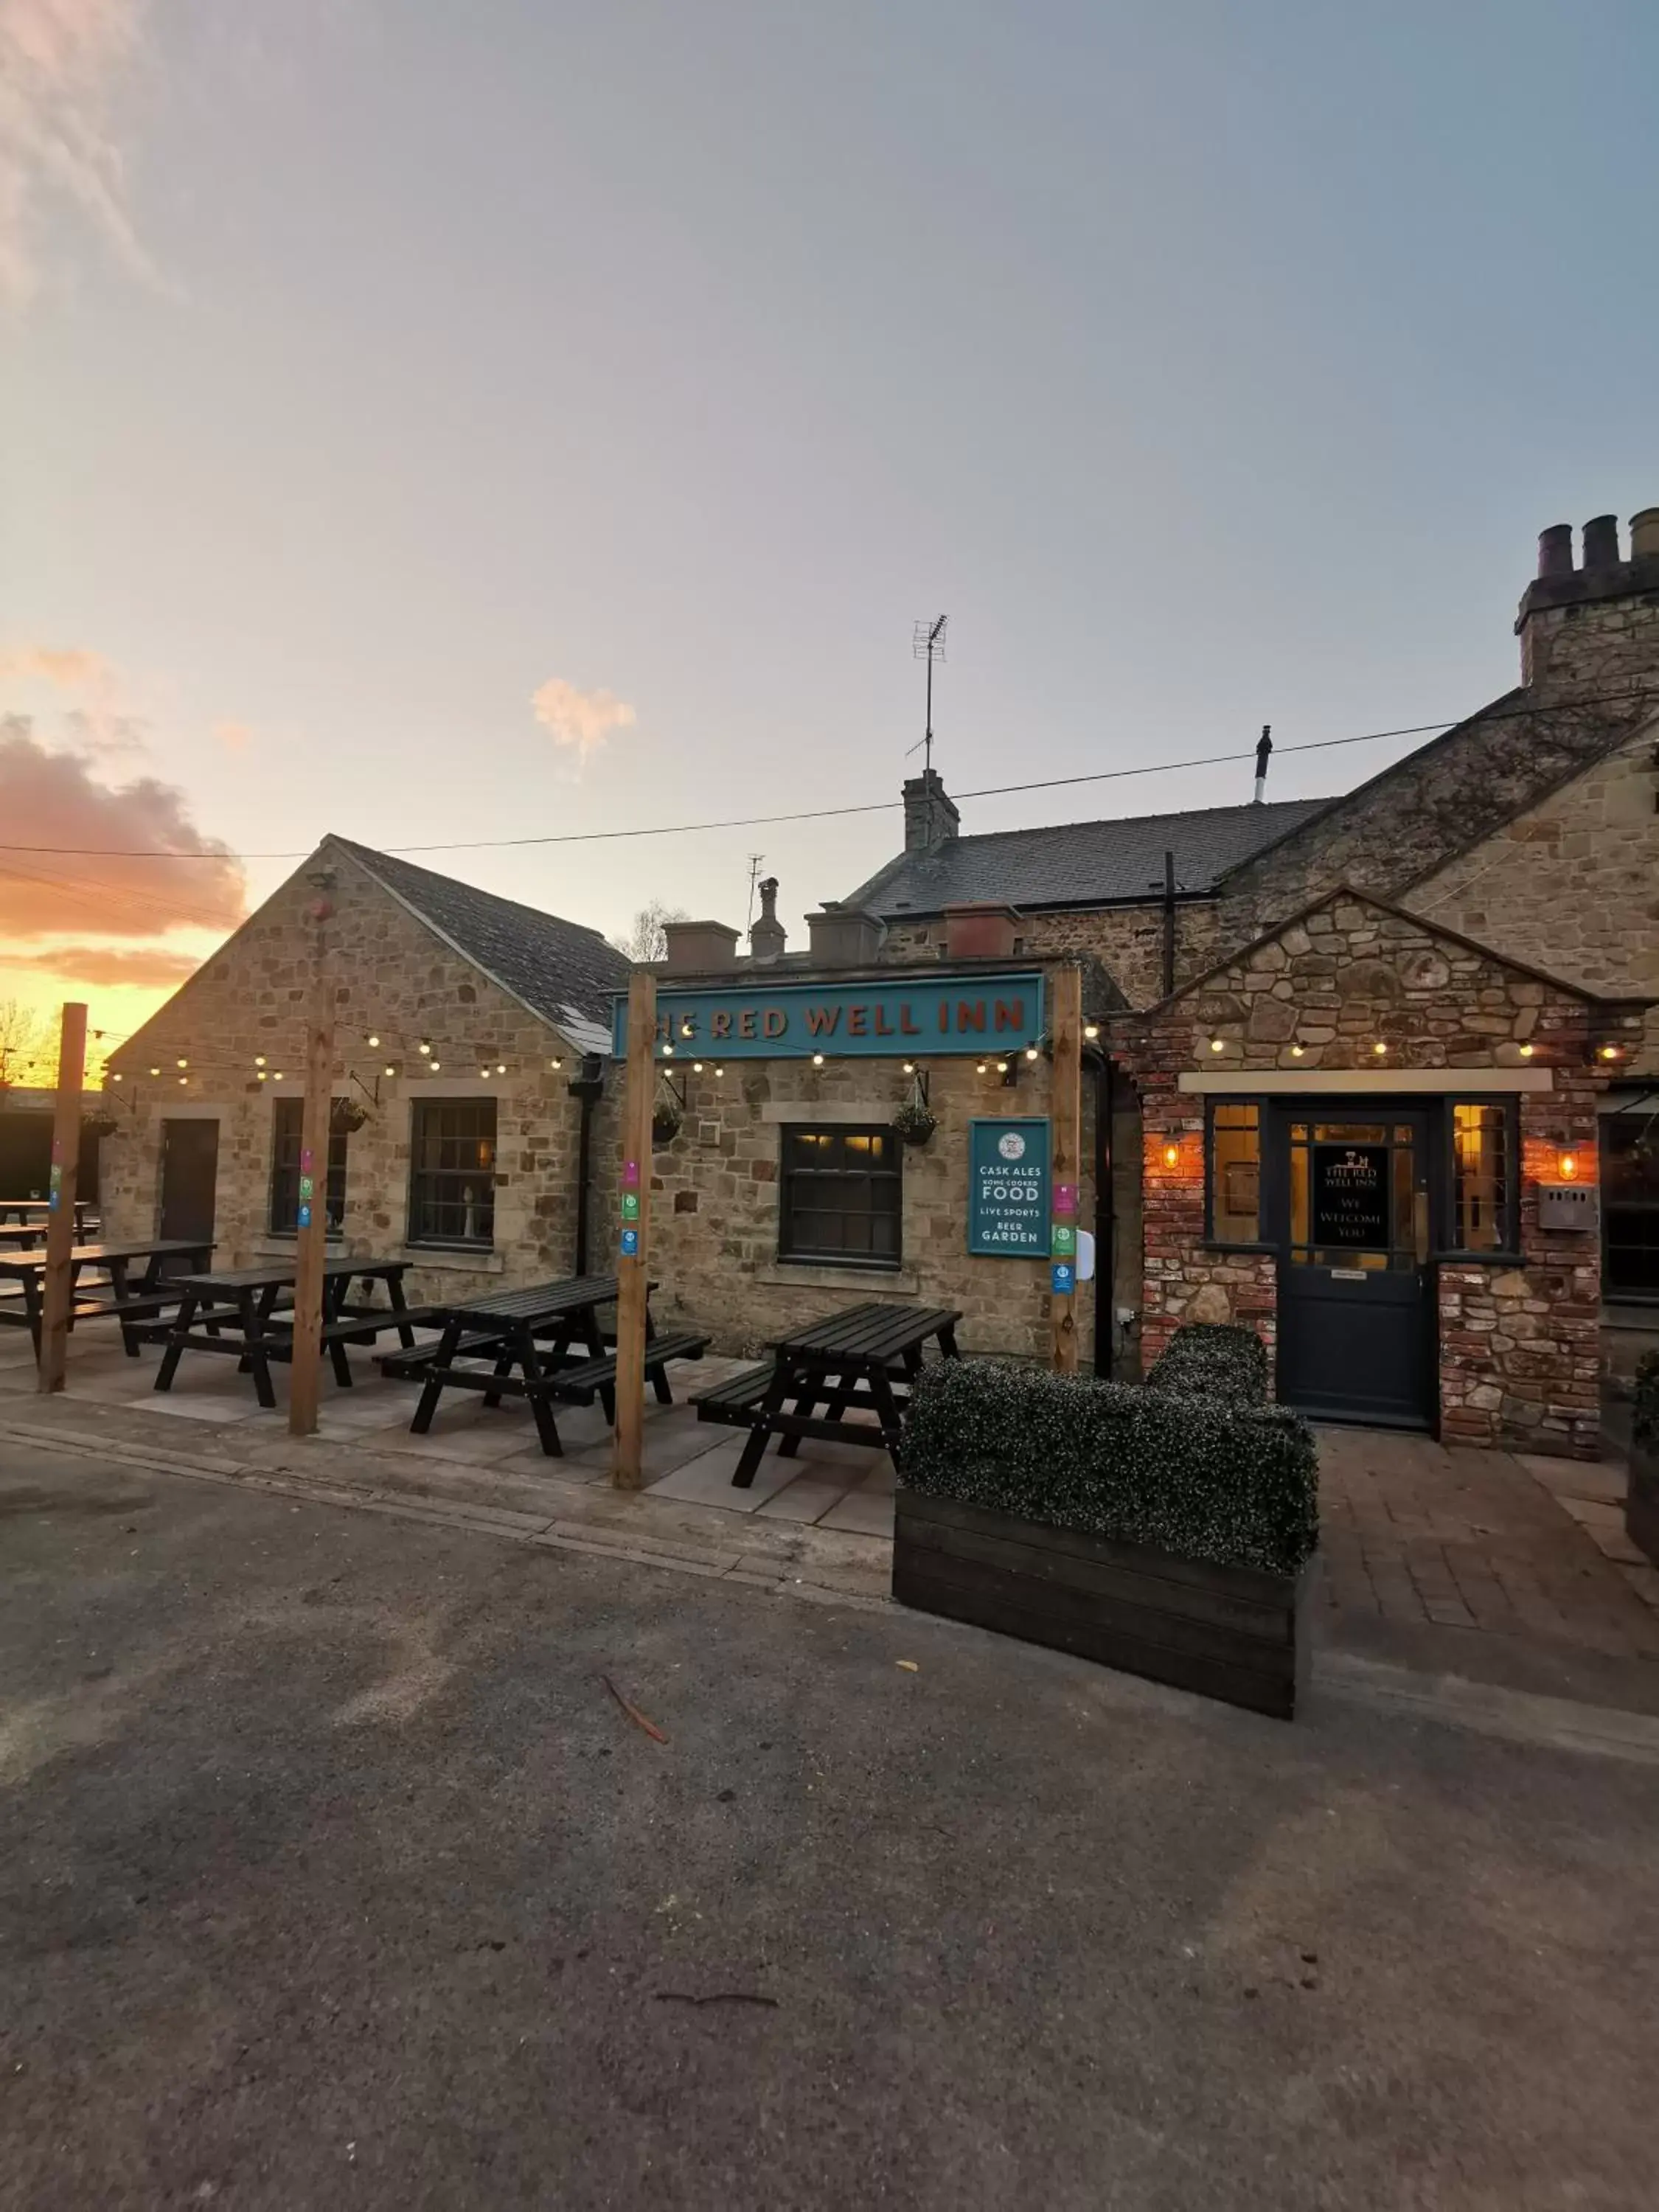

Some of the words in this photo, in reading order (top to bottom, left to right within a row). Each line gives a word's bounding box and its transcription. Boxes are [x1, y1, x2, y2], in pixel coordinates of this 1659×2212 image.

[655, 1012, 697, 1040] HE
[711, 1008, 790, 1040] RED
[805, 1002, 922, 1037] WELL
[937, 998, 1025, 1034] INN
[980, 1166, 1009, 1175] CASK
[1013, 1167, 1041, 1176] ALES
[1325, 1167, 1349, 1178] THE
[1353, 1168, 1377, 1178] RED
[1324, 1178, 1352, 1186] WELL
[1356, 1178, 1377, 1187] INN
[983, 1186, 1038, 1201] FOOD
[980, 1206, 1001, 1216] LIVE
[1004, 1208, 1040, 1217] SPORTS
[997, 1222, 1023, 1231] BEER
[981, 1231, 1037, 1243] GARDEN
[1338, 1227, 1366, 1238] YOU
